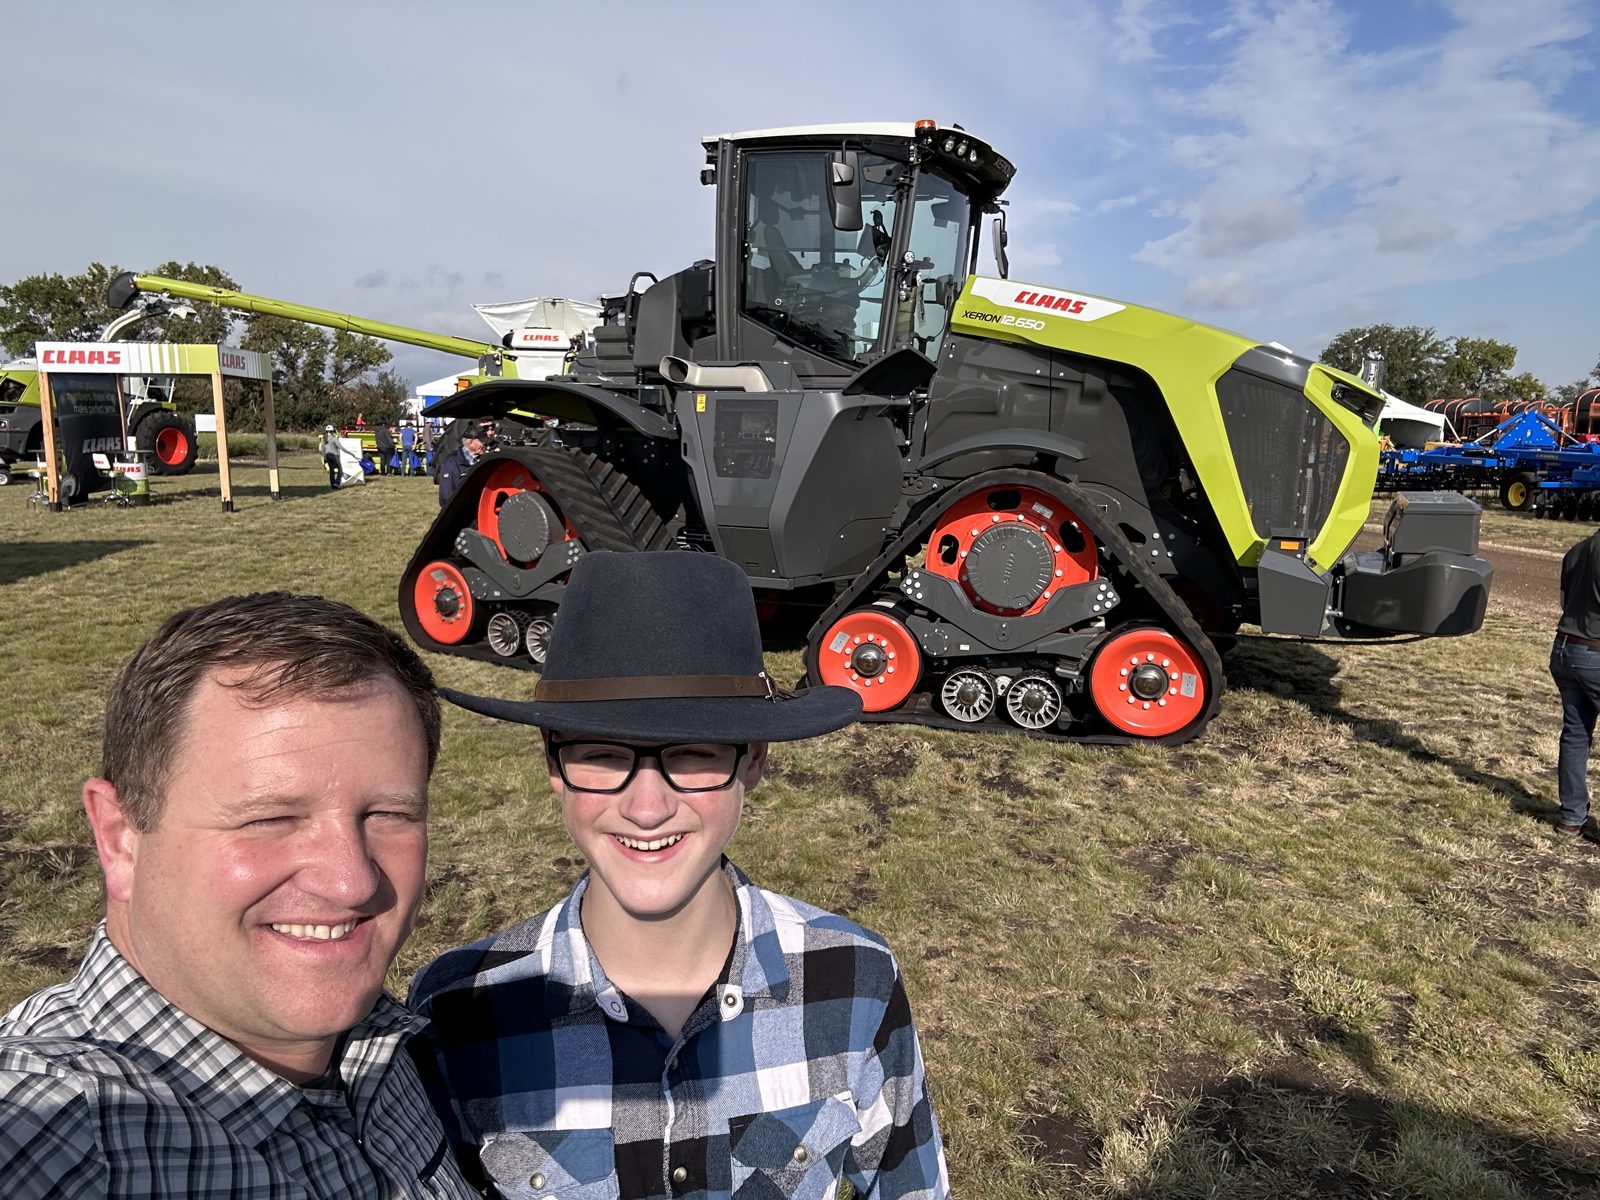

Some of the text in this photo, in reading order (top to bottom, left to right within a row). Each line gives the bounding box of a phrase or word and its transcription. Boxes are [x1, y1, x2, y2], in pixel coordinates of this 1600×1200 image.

[1014, 290, 1087, 314] CLAAS
[962, 310, 1046, 331] XERION 12.650
[42, 350, 121, 365] CLAAS
[221, 352, 246, 370] CLAAS
[83, 436, 122, 453] CLAAS
